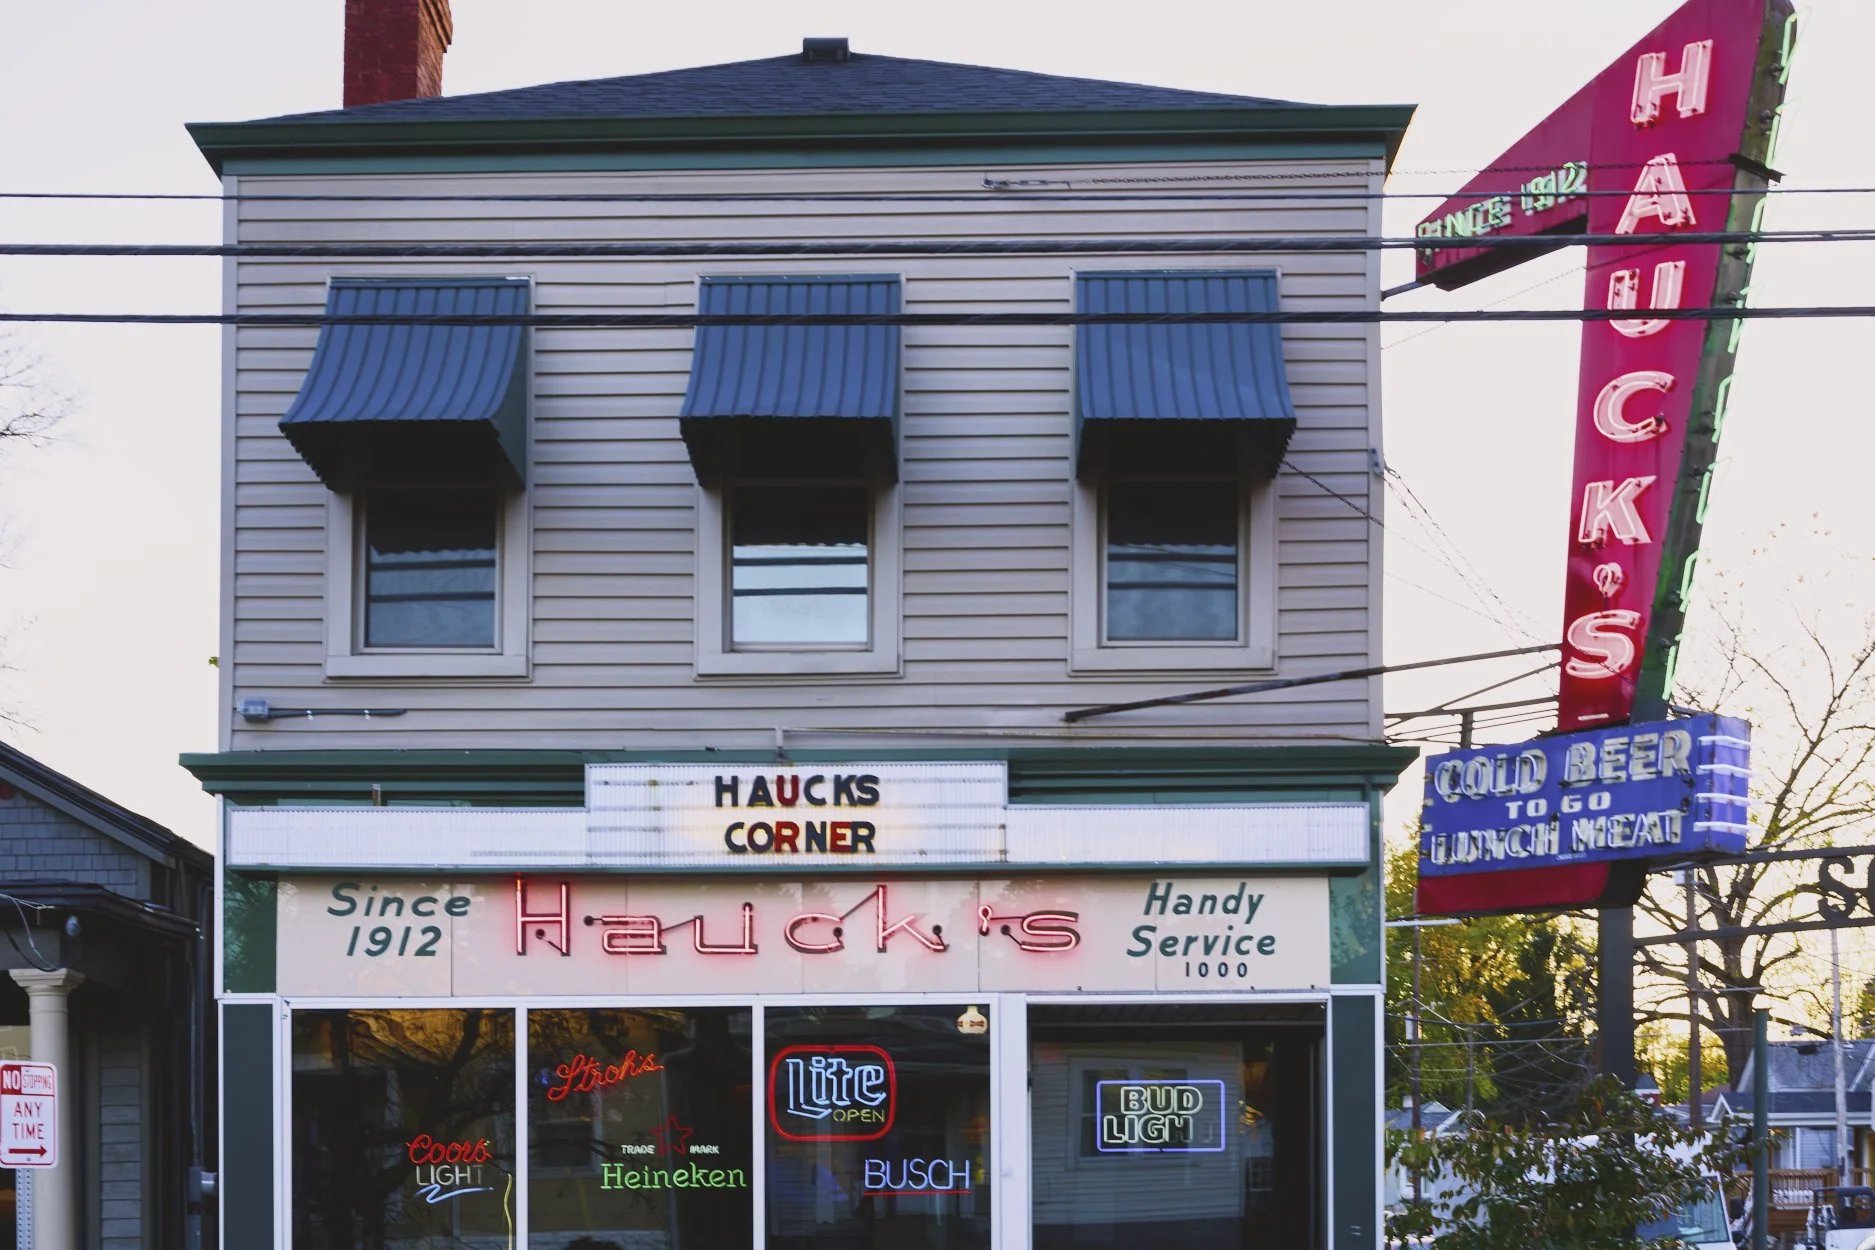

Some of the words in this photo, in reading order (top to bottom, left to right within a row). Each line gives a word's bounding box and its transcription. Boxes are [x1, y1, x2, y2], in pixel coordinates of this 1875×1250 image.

[1520, 160, 1588, 217] 1912
[1565, 38, 1713, 680] HAUCK'S
[1433, 748, 1548, 804] COLD
[1563, 729, 1692, 787] BEER
[715, 773, 880, 807] HAUCKS
[1504, 798, 1548, 820] TO
[1560, 790, 1612, 814] GO
[723, 820, 877, 854] CORNER
[1430, 819, 1560, 866] LUNCH
[1571, 807, 1688, 851] MEAT
[327, 881, 472, 918] Since
[1142, 881, 1265, 925] Handy
[1817, 854, 1875, 924] S
[346, 925, 443, 957] 1912
[1126, 924, 1277, 958] Service
[1184, 961, 1249, 979] 1000
[4, 1070, 20, 1089] NO
[23, 1075, 52, 1089] STOPPING
[546, 1048, 666, 1103] Stroh's
[785, 1055, 888, 1121] Lite
[14, 1101, 42, 1118] ANY
[832, 1109, 885, 1122] OPEN
[1120, 1086, 1204, 1116] BUD
[12, 1123, 45, 1140] TIME
[406, 1133, 493, 1165] Coors
[620, 1144, 656, 1155] TRADE
[689, 1143, 721, 1155] MARK
[415, 1164, 484, 1186] LIGHT
[600, 1161, 748, 1191] Heineken
[863, 1158, 971, 1190] BUSCH
